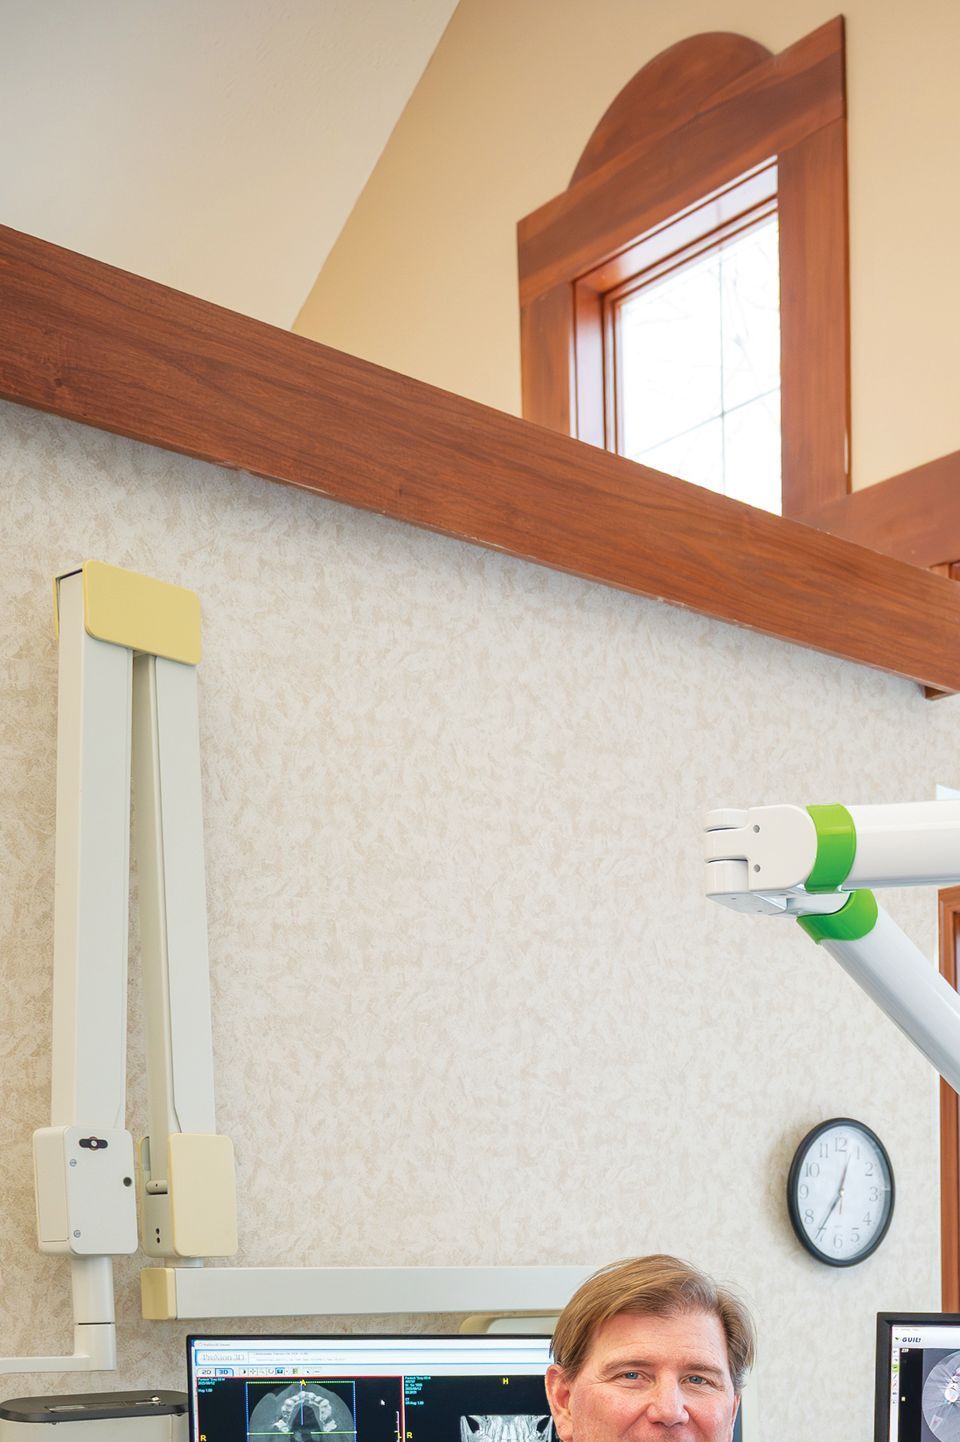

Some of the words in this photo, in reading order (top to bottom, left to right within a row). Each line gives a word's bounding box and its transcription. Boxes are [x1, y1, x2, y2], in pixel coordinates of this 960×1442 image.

[819, 1142, 829, 1159] 11
[834, 1137, 848, 1152] 12
[804, 1161, 820, 1178] 10
[864, 1162, 873, 1177] 2
[799, 1183, 809, 1200] 9
[868, 1186, 879, 1202] 3
[804, 1208, 815, 1225] 8
[863, 1211, 873, 1226] 4
[833, 1232, 843, 1249] 6
[850, 1226, 860, 1243] 5
[301, 1378, 307, 1386] A
[503, 1377, 509, 1385] H
[200, 1434, 207, 1442] R
